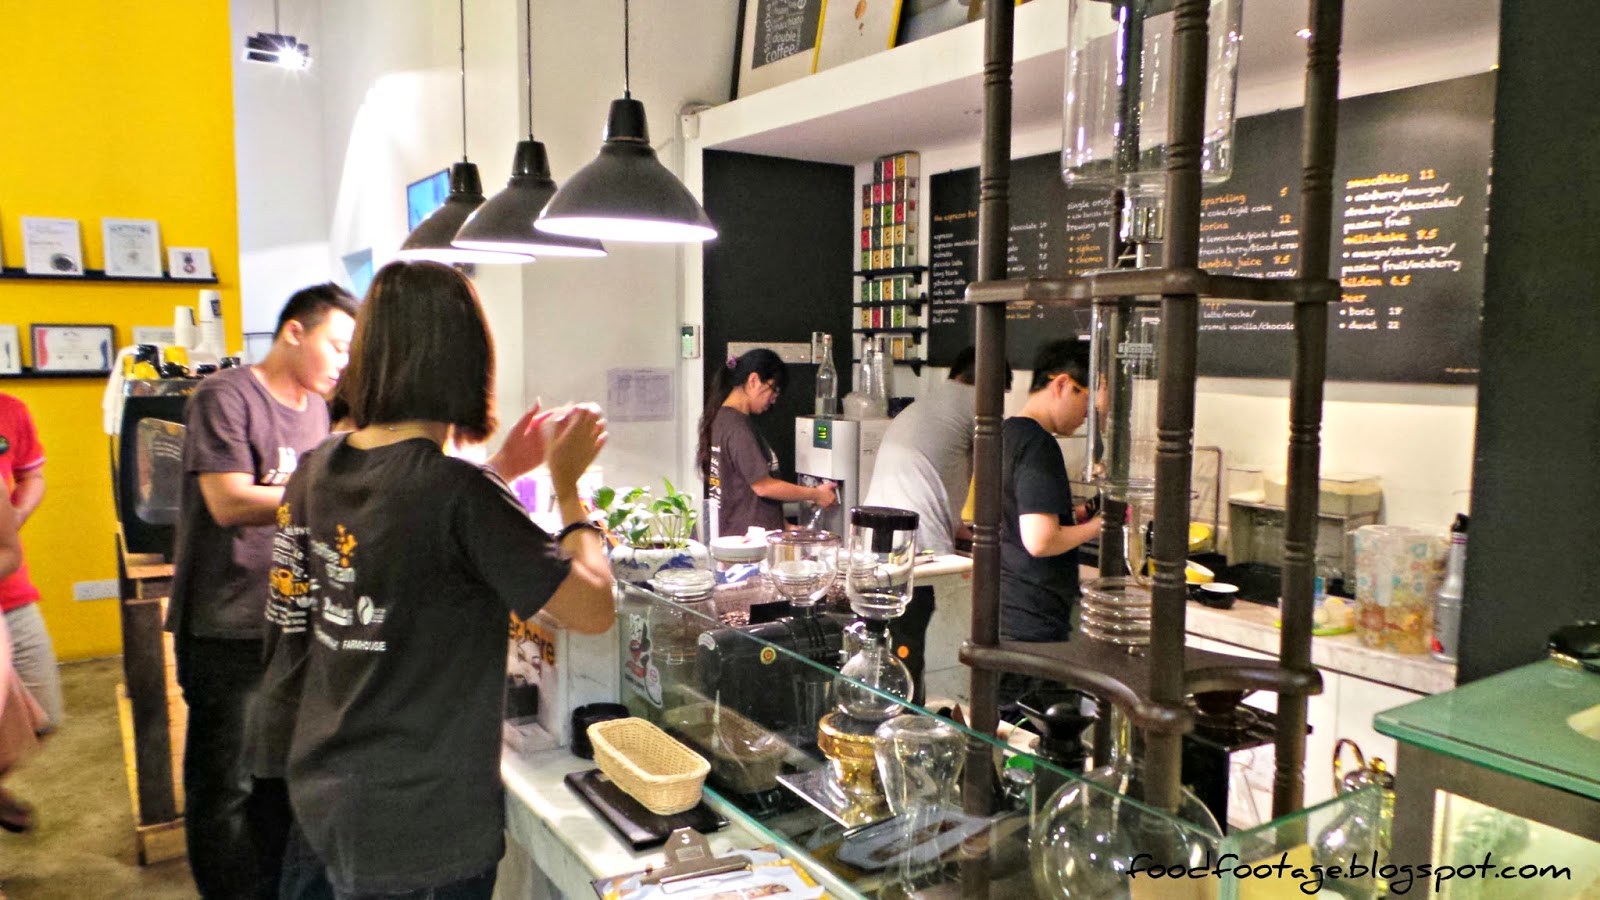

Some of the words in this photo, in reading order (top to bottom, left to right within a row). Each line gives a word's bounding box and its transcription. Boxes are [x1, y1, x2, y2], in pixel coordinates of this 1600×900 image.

[772, 31, 797, 43] double
[766, 43, 796, 63] coffee
[1346, 172, 1411, 190] smoothies
[1067, 200, 1091, 211] single
[1092, 197, 1111, 208] origi
[1200, 193, 1248, 210] sparkling
[1279, 186, 1289, 198] 5
[1207, 204, 1250, 217] coke/light
[1251, 204, 1274, 213] coke
[1344, 195, 1465, 217] strawberry/chocolate/
[1278, 213, 1293, 225] 12
[1384, 214, 1412, 229] fruit
[1010, 223, 1037, 232] chocolate
[1066, 222, 1097, 233] brewing
[1206, 230, 1270, 243] lemonade/pink
[1270, 229, 1300, 239] lemon
[1342, 230, 1410, 246] milkshake
[1225, 241, 1279, 257] berry/blood
[1235, 256, 1265, 271] juice
[1199, 321, 1227, 331] aramel
[1386, 320, 1401, 330] 22
